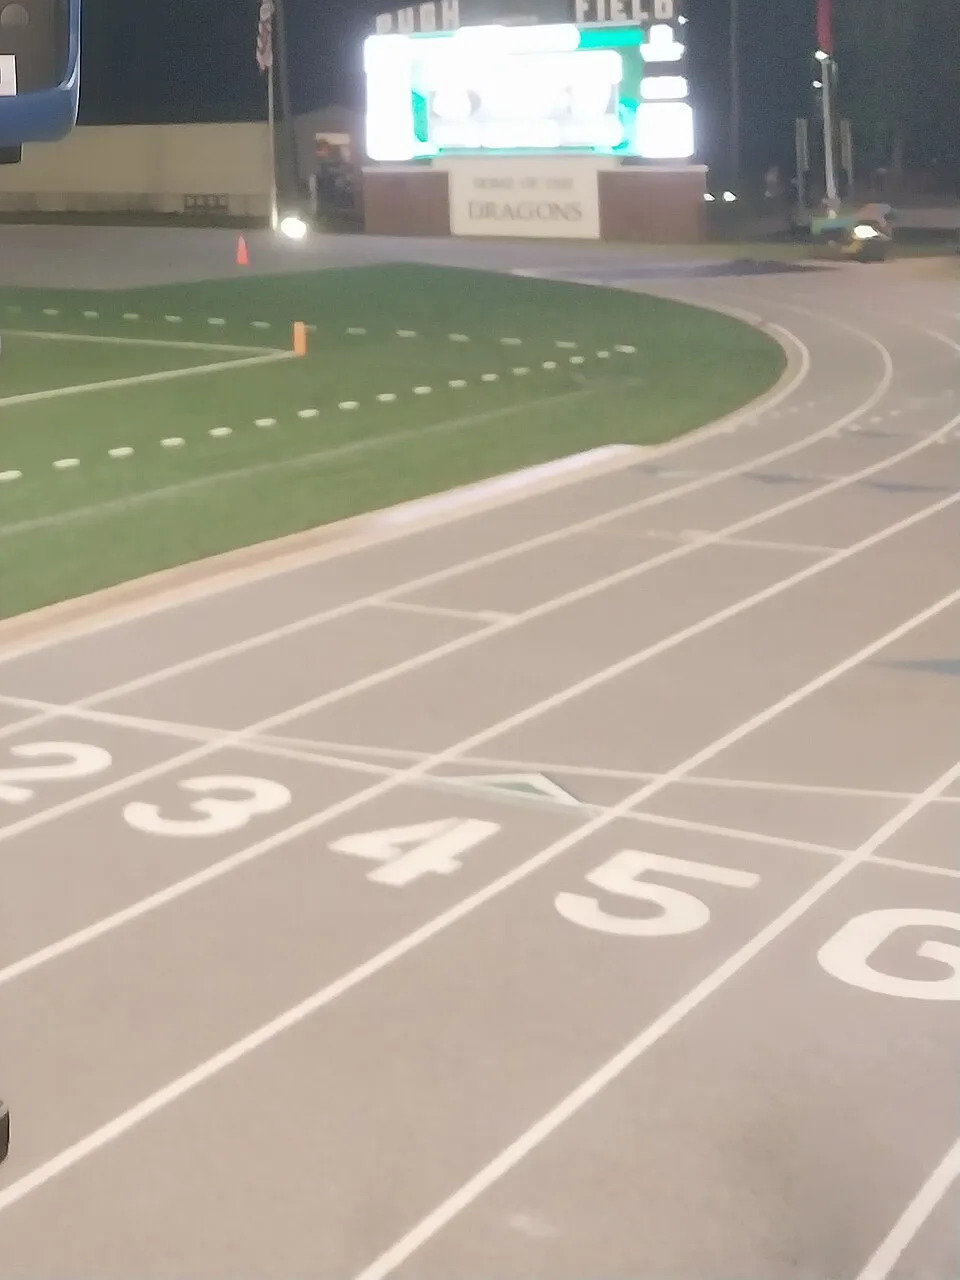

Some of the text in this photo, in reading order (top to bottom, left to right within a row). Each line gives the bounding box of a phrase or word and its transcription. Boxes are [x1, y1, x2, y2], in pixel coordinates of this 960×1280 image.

[468, 200, 583, 221] DRAGONS
[122, 775, 292, 838] 3
[328, 818, 500, 888] 4
[554, 848, 761, 938] 5
